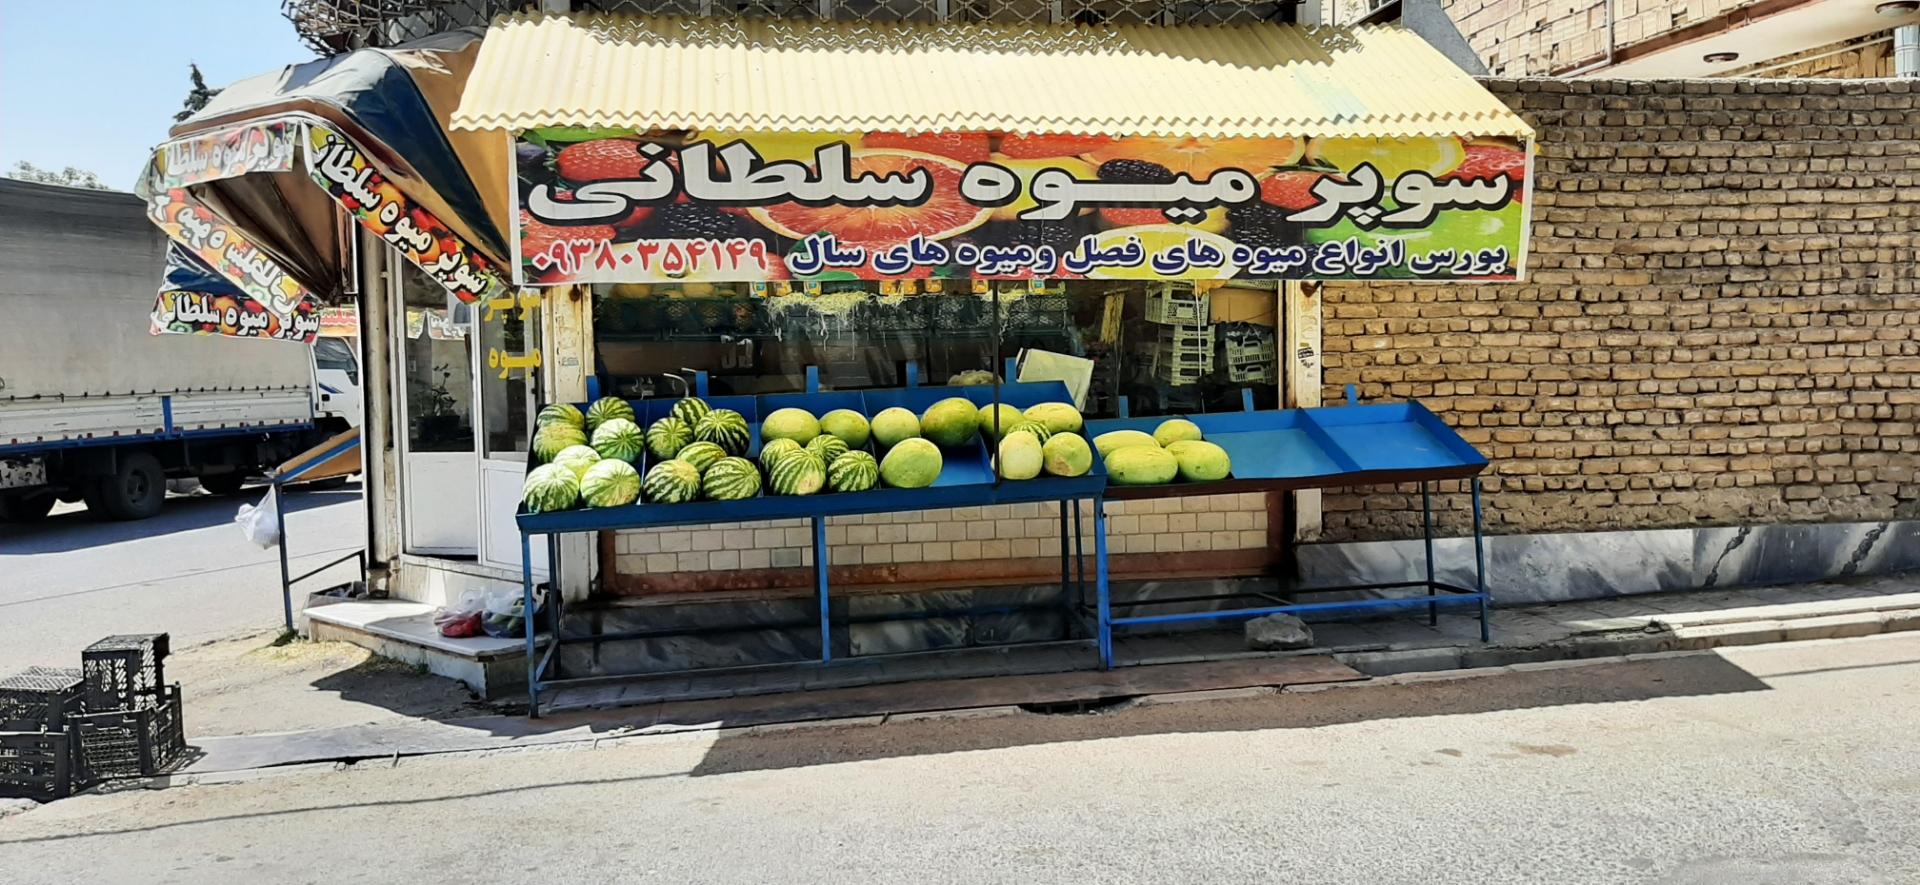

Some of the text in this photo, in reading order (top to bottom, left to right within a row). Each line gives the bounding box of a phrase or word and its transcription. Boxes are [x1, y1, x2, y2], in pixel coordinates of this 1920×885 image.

[527, 141, 1511, 228] سوپر میوه سلطانی
[383, 200, 432, 253] میوه
[532, 238, 768, 274] ۰۹۳۸۰۳۵۴۱۴۹
[785, 233, 865, 274] سال
[874, 234, 949, 273] های
[1065, 234, 1146, 273] فصل
[1152, 235, 1224, 273] های
[1232, 244, 1305, 274] میوه
[1313, 238, 1405, 275] انواع
[1409, 244, 1511, 275] بورس
[420, 252, 487, 294] سوپر
[225, 305, 270, 337] میوه
[488, 346, 542, 380] میوه
